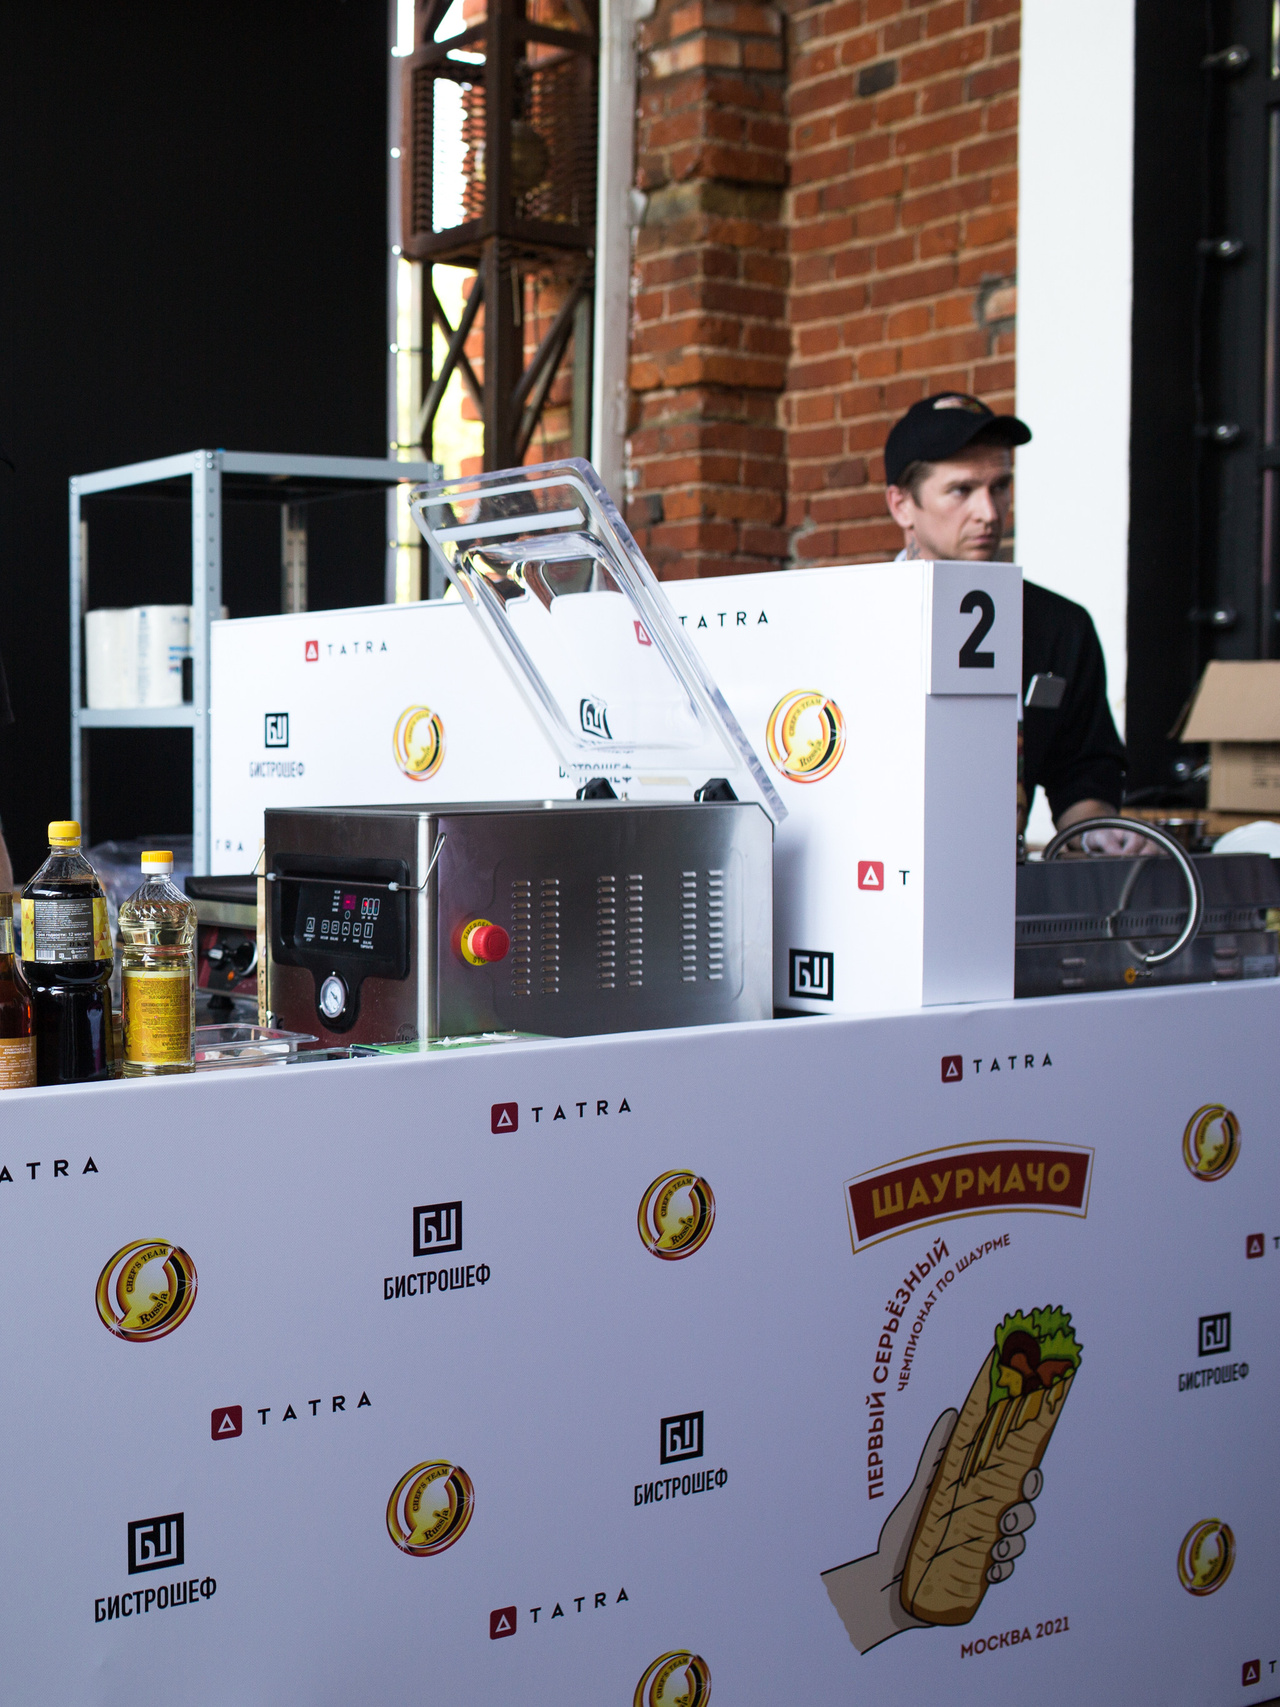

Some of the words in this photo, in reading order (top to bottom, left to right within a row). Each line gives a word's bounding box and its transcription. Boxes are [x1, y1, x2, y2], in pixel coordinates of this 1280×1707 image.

[327, 641, 388, 655] TATRA
[958, 589, 996, 668] 2
[973, 1054, 1051, 1073] TATRA
[532, 1098, 630, 1122] TATRA
[672, 1178, 692, 1190] TEAM
[872, 1162, 1071, 1219] ШАУРМАЧО
[126, 1261, 142, 1292] CHEF'S
[141, 1248, 166, 1262] TEAM
[384, 1264, 490, 1300] БИСТРОШЕФ
[873, 1237, 950, 1383] СЕРЬЁЗНЫЙ
[897, 1290, 938, 1392] ЧЕМПИОНАТ
[936, 1269, 955, 1293] ПО
[955, 1233, 1011, 1274] ШАУРМЕ
[1179, 1363, 1248, 1392] БИСТРОШЕФ
[258, 1392, 371, 1425] TATRA
[865, 1391, 886, 1500] ПЕРВЫЙ
[413, 1482, 427, 1512] CHEF'S
[425, 1468, 448, 1482] TEAM
[634, 1468, 728, 1507] БИСТРОШЕФ
[95, 1576, 217, 1623] БИСТРОШЕФ
[530, 1588, 628, 1623] TATRA
[960, 1627, 1032, 1659] МОСКВА
[1035, 1616, 1069, 1639] 2021
